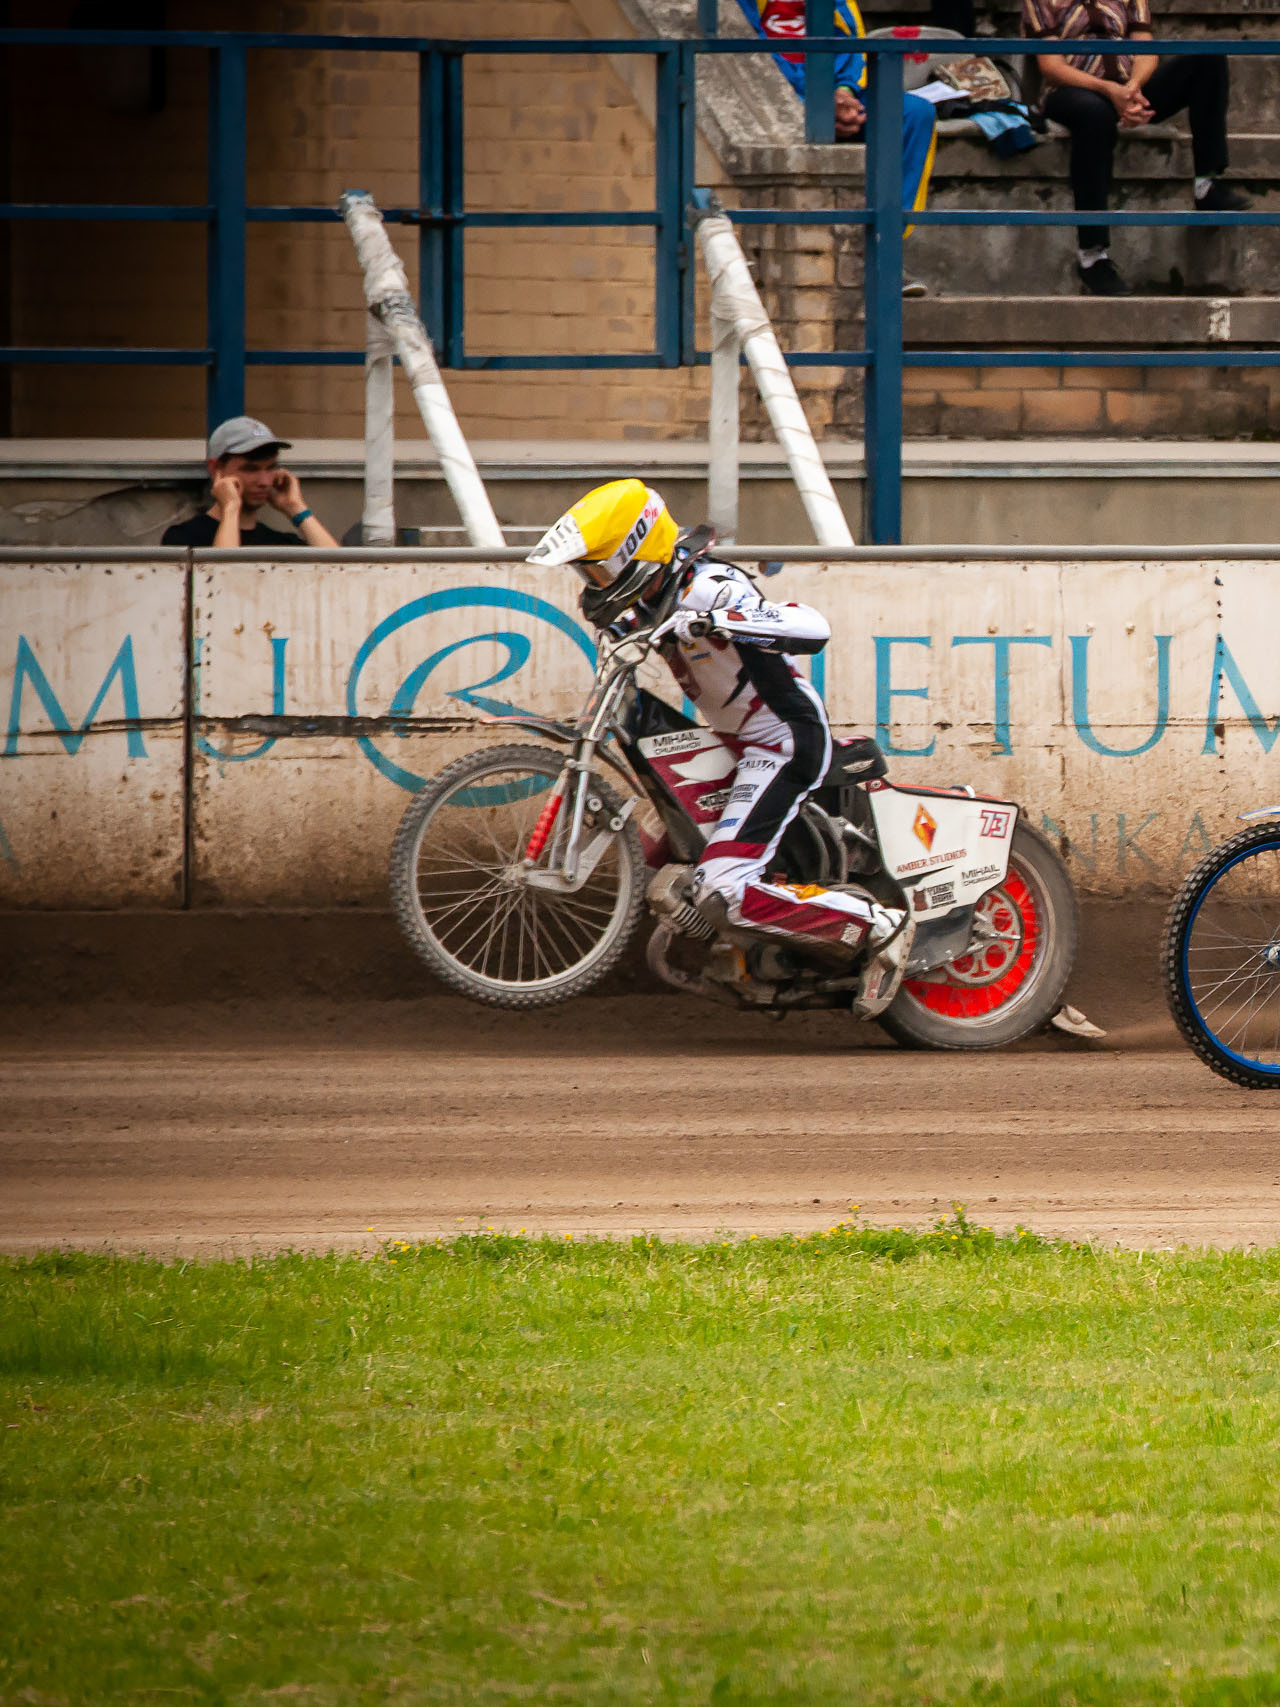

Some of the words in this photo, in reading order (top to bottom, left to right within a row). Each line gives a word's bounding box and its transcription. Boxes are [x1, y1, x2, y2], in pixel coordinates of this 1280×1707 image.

[652, 732, 700, 748] MIHAIL
[980, 809, 1010, 839] 73
[896, 859, 927, 873] AMBER
[928, 848, 967, 867] STUDIOS
[961, 864, 1001, 880] MIHAIL
